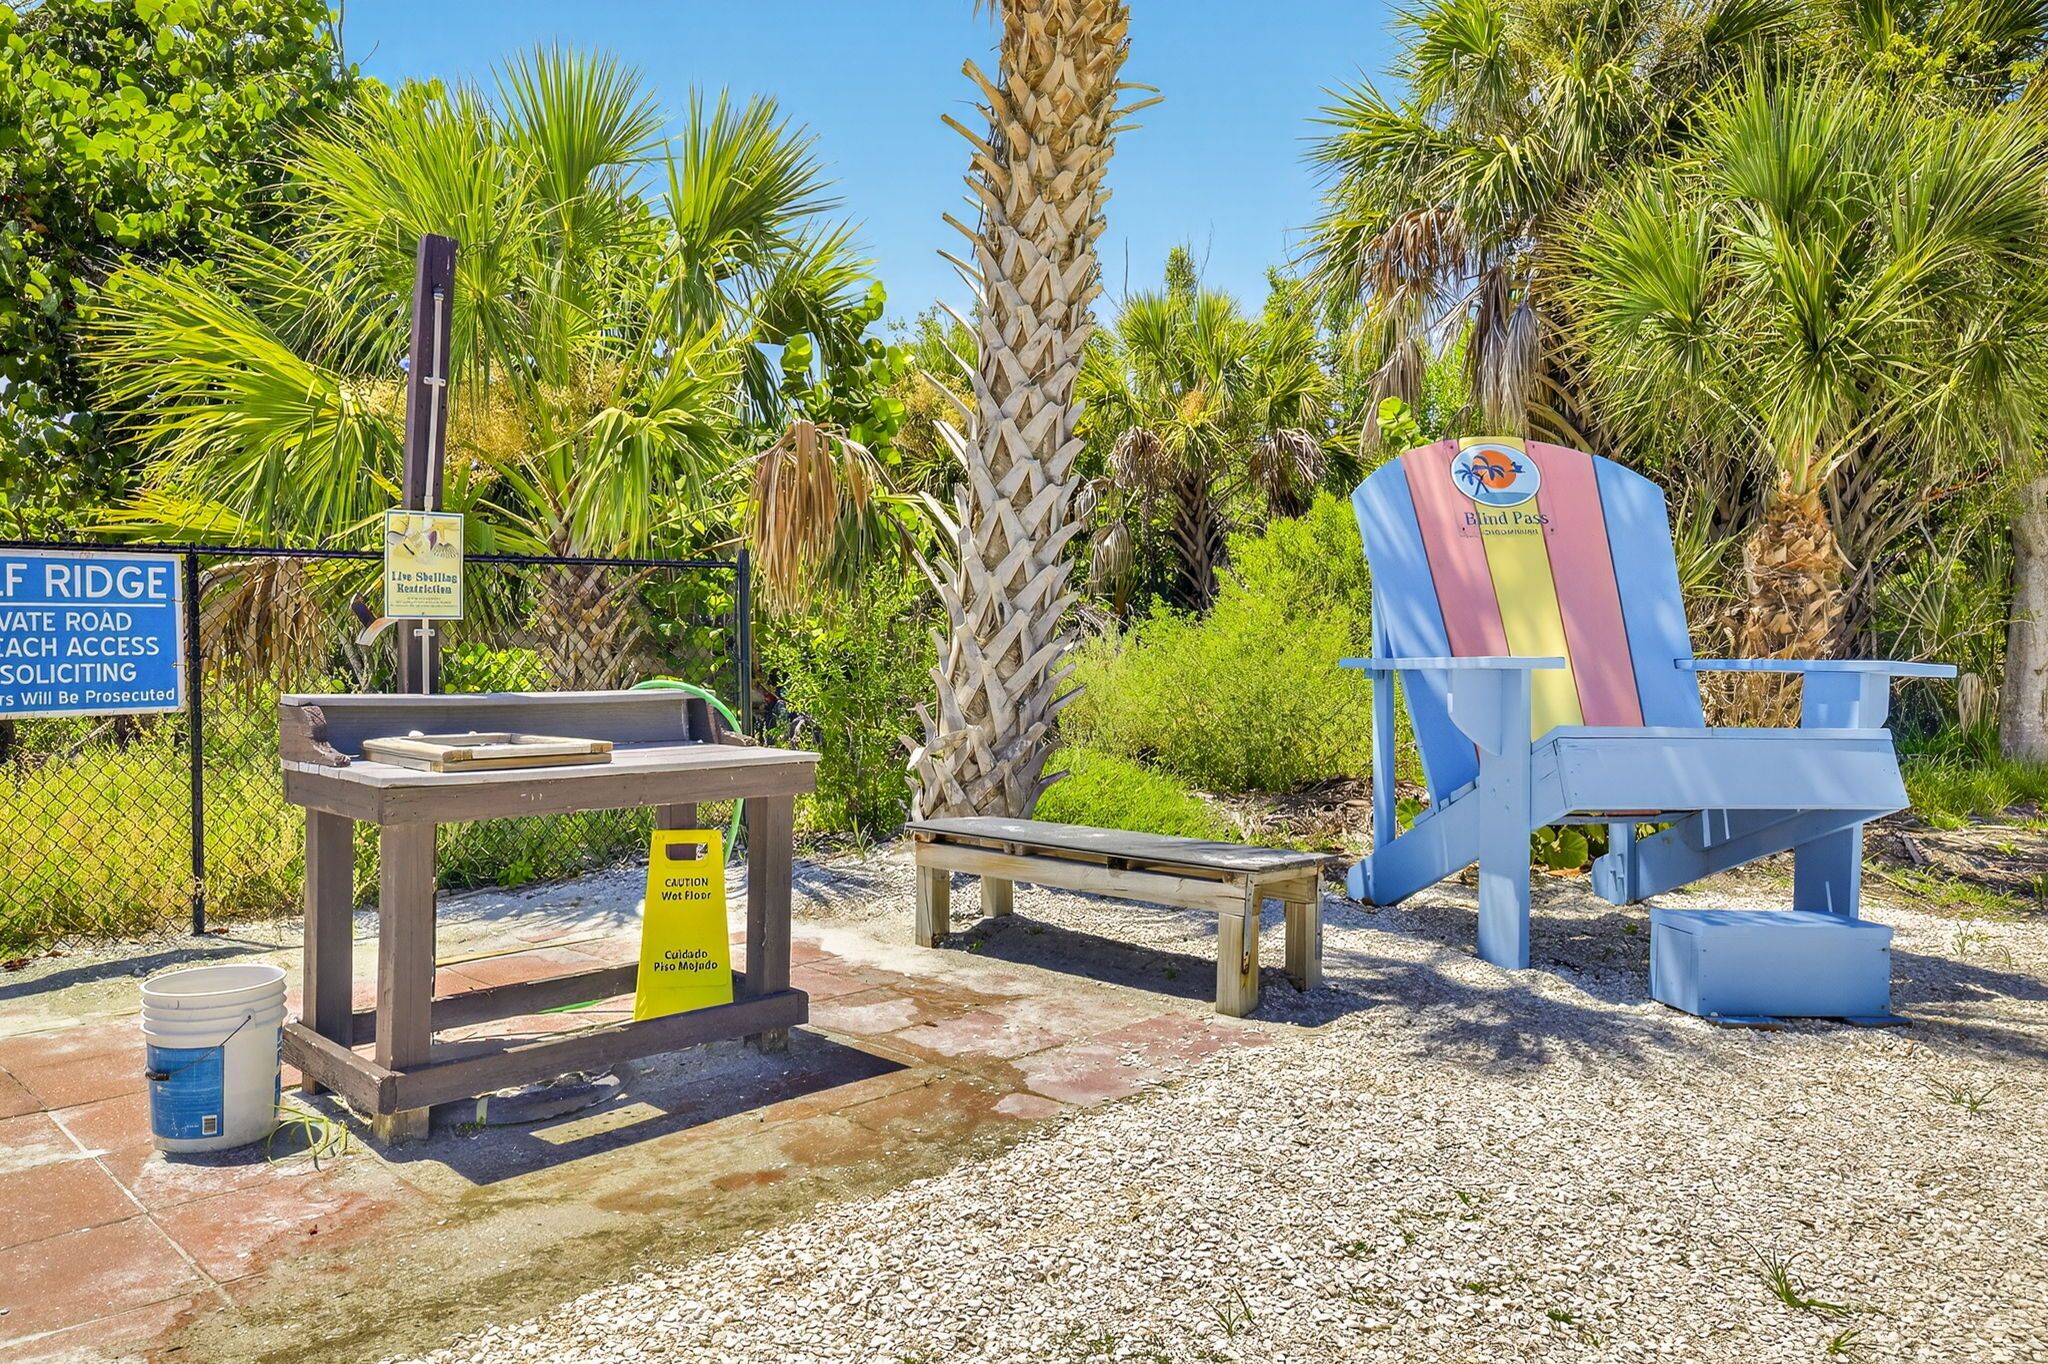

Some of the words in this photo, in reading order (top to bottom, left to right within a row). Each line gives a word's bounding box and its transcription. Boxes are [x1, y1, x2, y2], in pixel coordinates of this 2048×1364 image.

[1465, 511, 1509, 526] Blind
[1512, 511, 1549, 525] Pass
[0, 563, 28, 597] F
[45, 564, 167, 599] RIDGE
[391, 571, 412, 582] Live
[416, 572, 458, 584] Shelling
[66, 611, 132, 632] ROAD
[66, 636, 160, 657] ACCESS
[0, 662, 137, 685] SOLICITING
[21, 691, 52, 706] Will
[59, 690, 79, 705] Be
[86, 687, 175, 703] Prosecuted
[665, 878, 709, 887] CAUTION
[661, 891, 682, 900] Wet
[685, 890, 711, 900] Floor
[665, 949, 708, 960] Cuidado
[654, 961, 676, 972] Piso
[678, 959, 718, 973] Mojado
